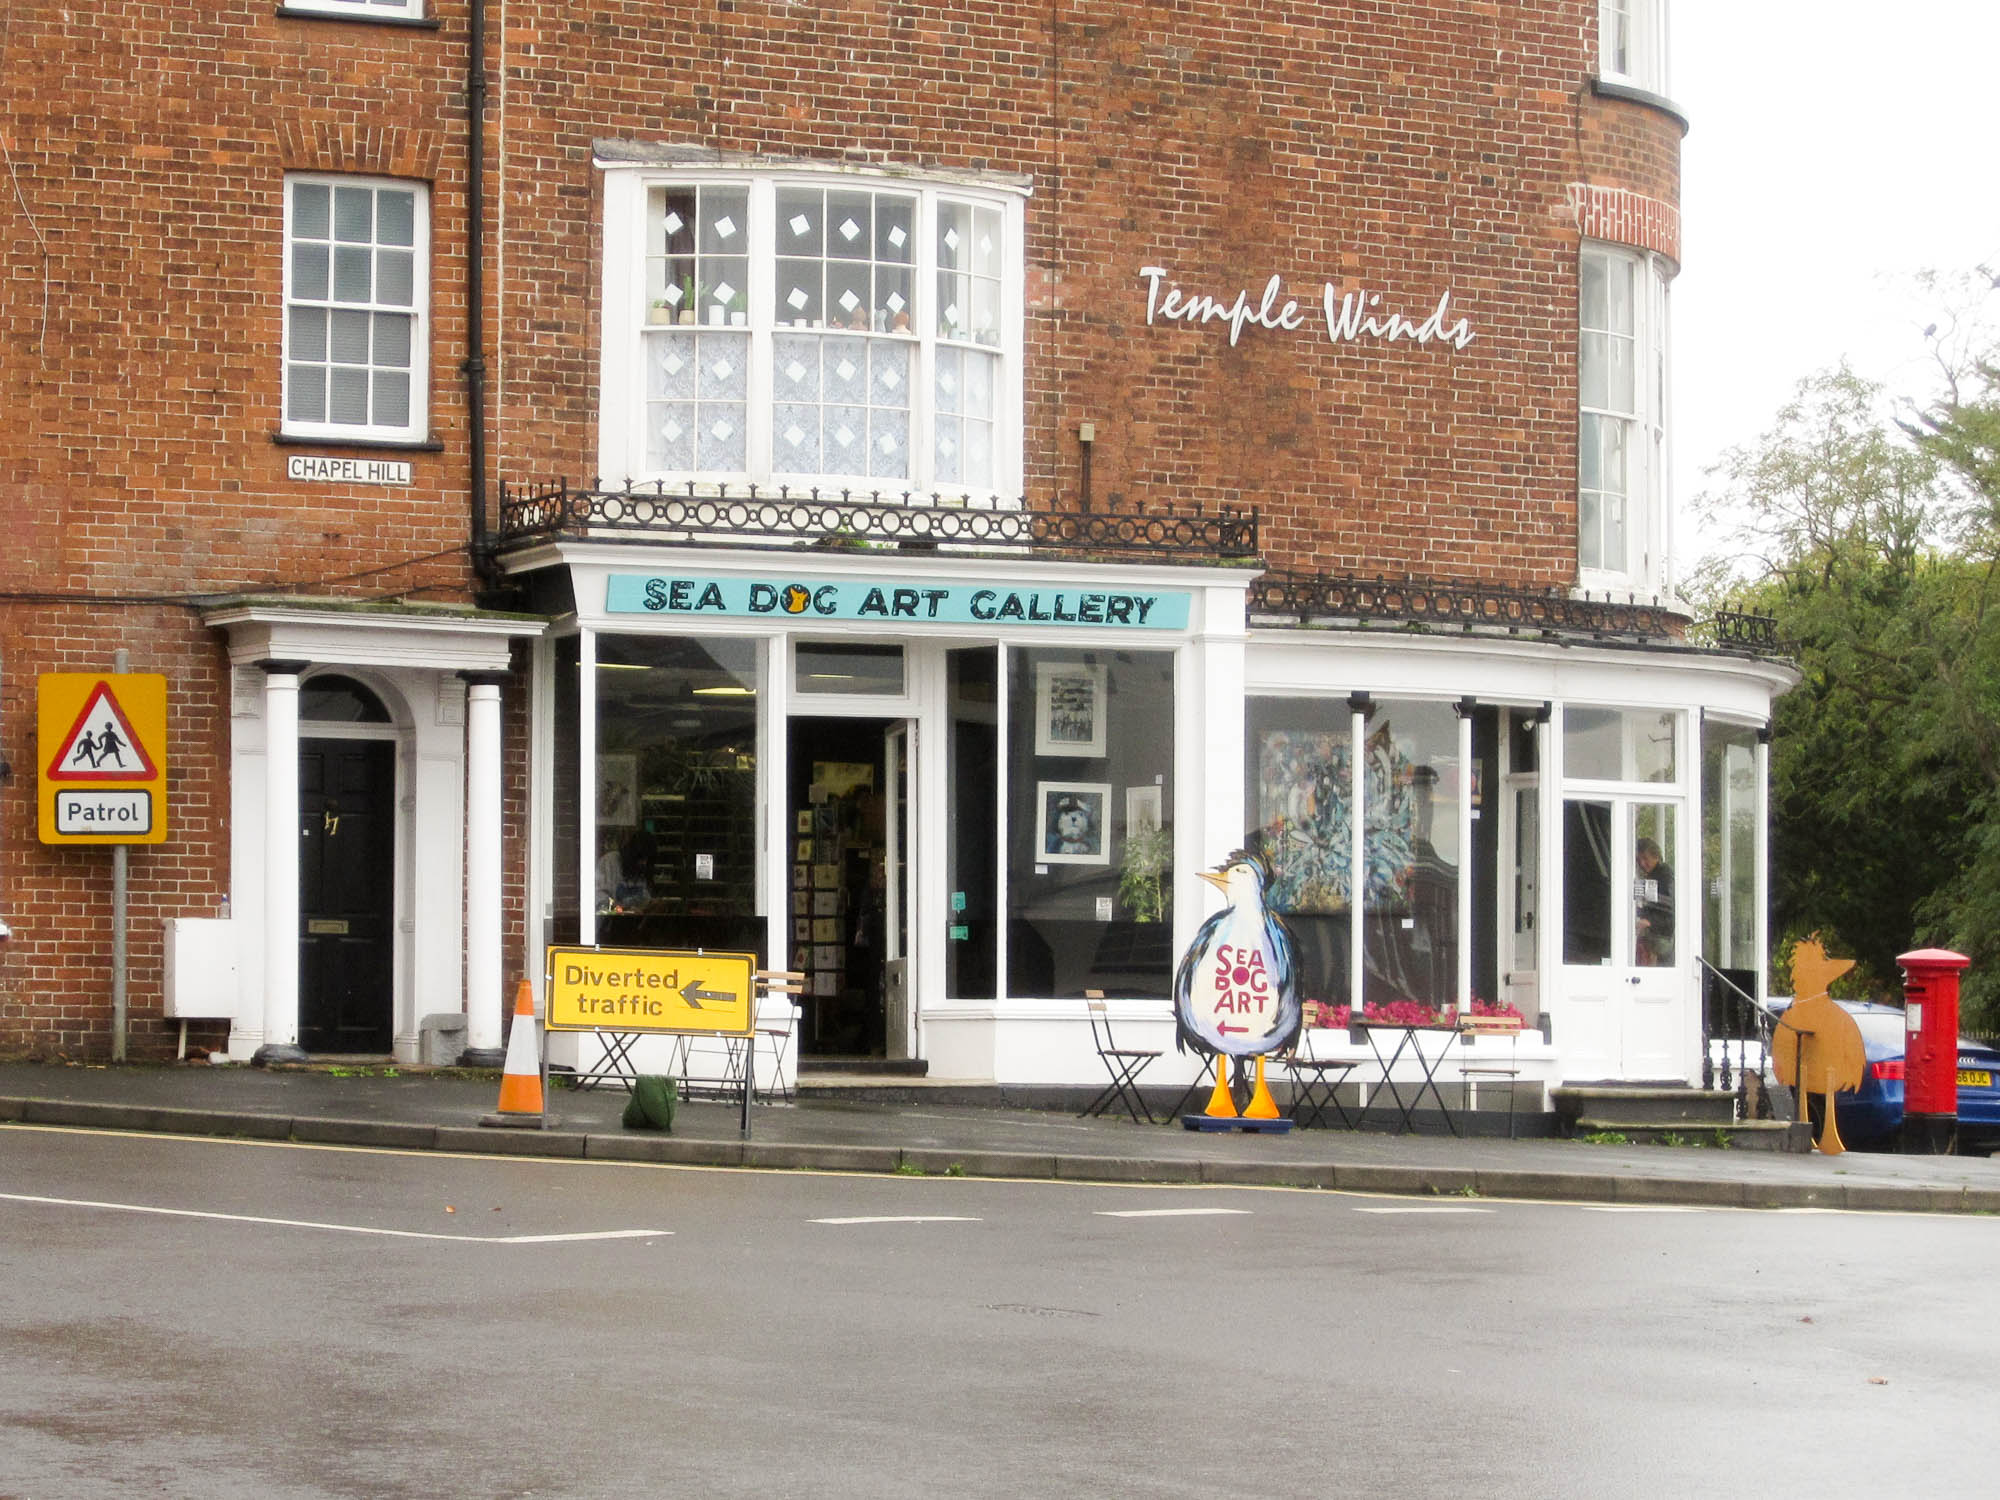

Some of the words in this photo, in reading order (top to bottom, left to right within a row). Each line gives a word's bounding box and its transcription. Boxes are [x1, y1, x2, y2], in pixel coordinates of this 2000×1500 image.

[1139, 266, 1305, 346] Temple
[1323, 281, 1476, 349] Winds
[291, 458, 362, 479] CHAPEL
[368, 462, 407, 481] HILL
[642, 578, 727, 611] SEA
[748, 583, 838, 615] DOG
[857, 587, 949, 617] ART
[969, 590, 1158, 624] GALLERY
[68, 802, 138, 821] Patrol
[1215, 944, 1265, 976] SEA
[565, 965, 679, 989] Diverted
[577, 993, 663, 1016] traffic
[1213, 988, 1270, 1014] ART
